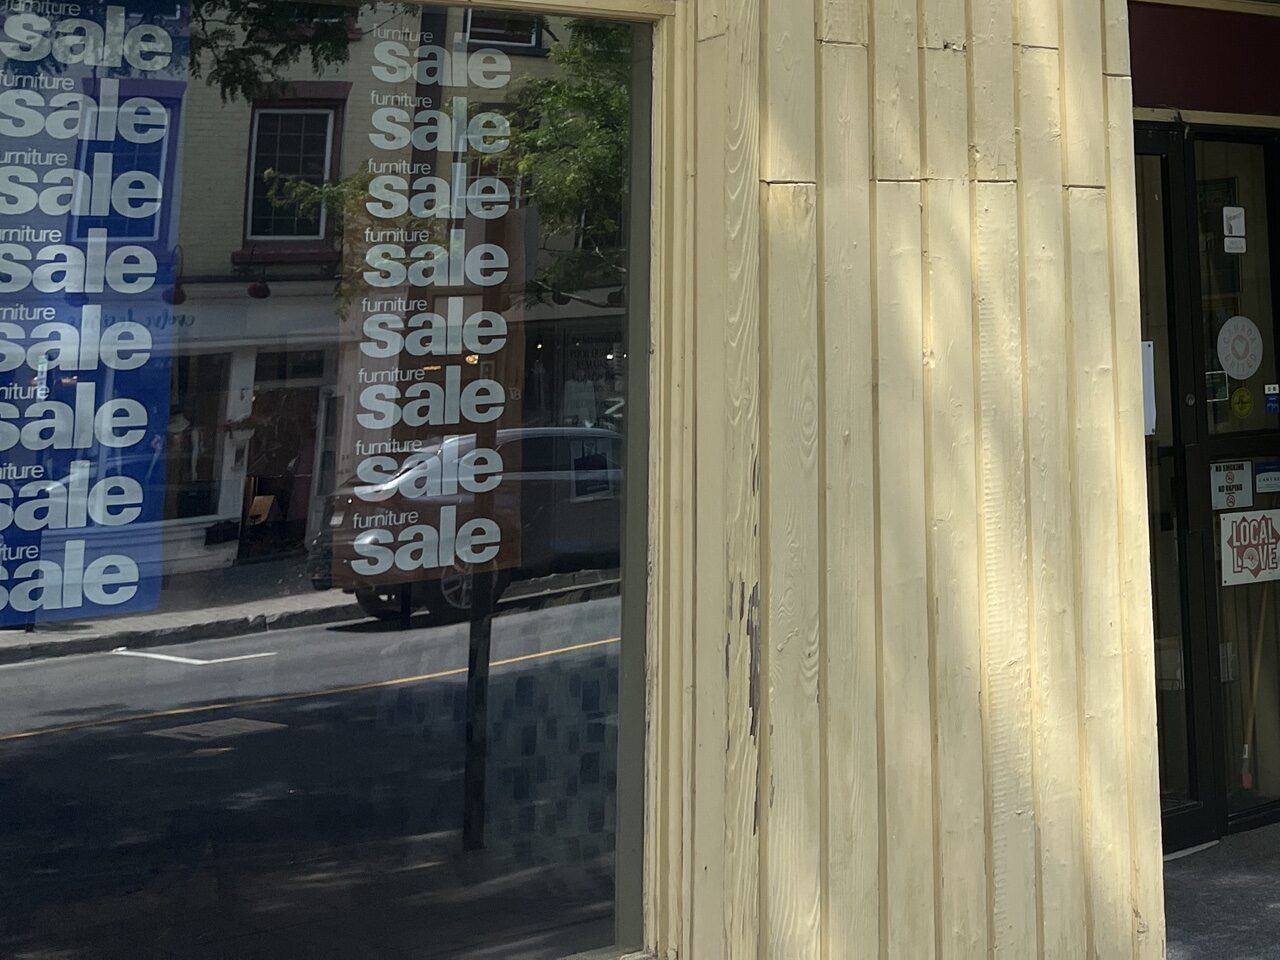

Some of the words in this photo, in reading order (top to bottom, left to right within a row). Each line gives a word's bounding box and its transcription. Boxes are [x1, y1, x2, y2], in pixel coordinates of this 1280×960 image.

[0, 6, 172, 71] sale
[371, 32, 512, 89] sale
[372, 23, 433, 43] furniture
[0, 79, 167, 144] sale
[368, 97, 511, 154] sale
[370, 91, 433, 108] furniture
[0, 149, 68, 166] urniture
[0, 152, 162, 218] sale
[368, 158, 431, 175] furniture
[366, 162, 510, 220] sale
[363, 229, 509, 287] sale
[364, 227, 430, 243] furniture
[359, 296, 508, 358] sale
[362, 297, 427, 313] furniture
[356, 365, 505, 430] sale
[358, 367, 425, 383] furniture
[353, 435, 503, 502] sale
[356, 439, 423, 456] furniture
[0, 460, 144, 532] ale
[353, 510, 419, 528] furniture
[351, 505, 501, 576] sale
[1232, 518, 1276, 546] LOCAL
[0, 540, 139, 612] ale
